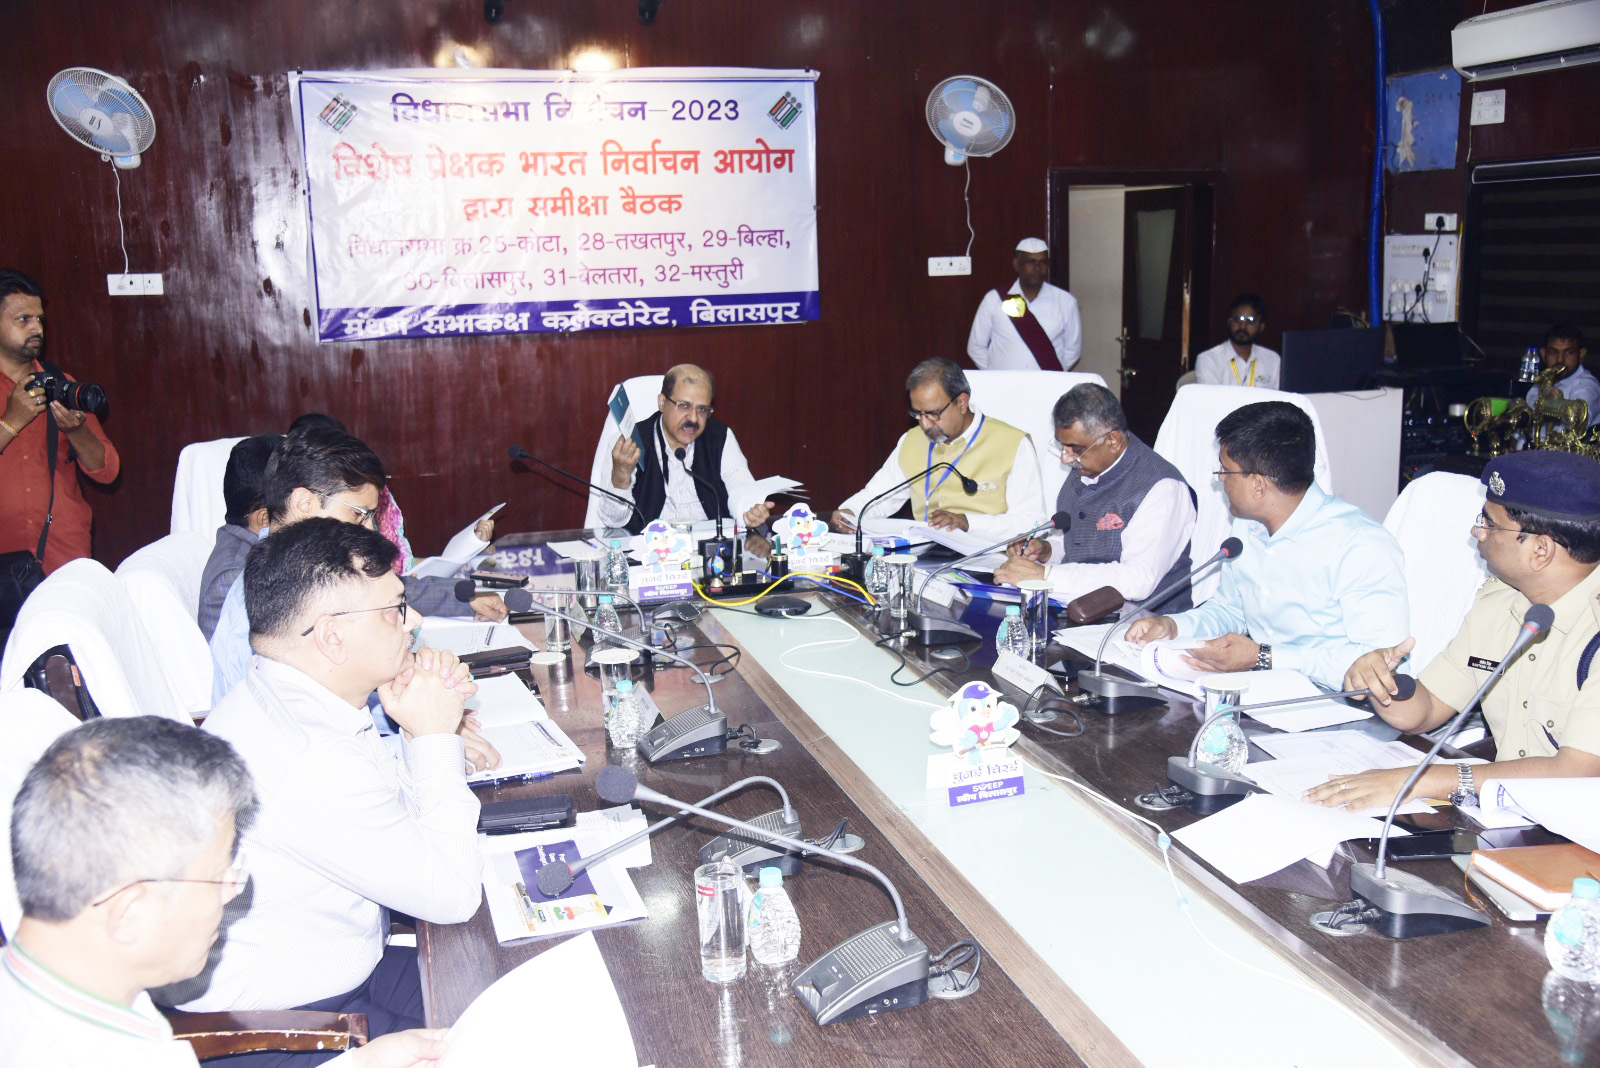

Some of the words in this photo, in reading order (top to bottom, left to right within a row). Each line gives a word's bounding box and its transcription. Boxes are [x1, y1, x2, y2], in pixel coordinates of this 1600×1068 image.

[332, 142, 413, 181] विशेष
[425, 143, 506, 180] प्रेक्षक
[519, 151, 588, 177] भारत
[600, 139, 701, 176] निर्वाचन
[713, 138, 795, 174] आयोग
[462, 198, 514, 222] द्वारा
[527, 186, 609, 218] समीक्षा
[620, 185, 683, 215] बैठक
[422, 312, 531, 334] सभाकक्ष
[689, 298, 801, 324] बिलासपुर
